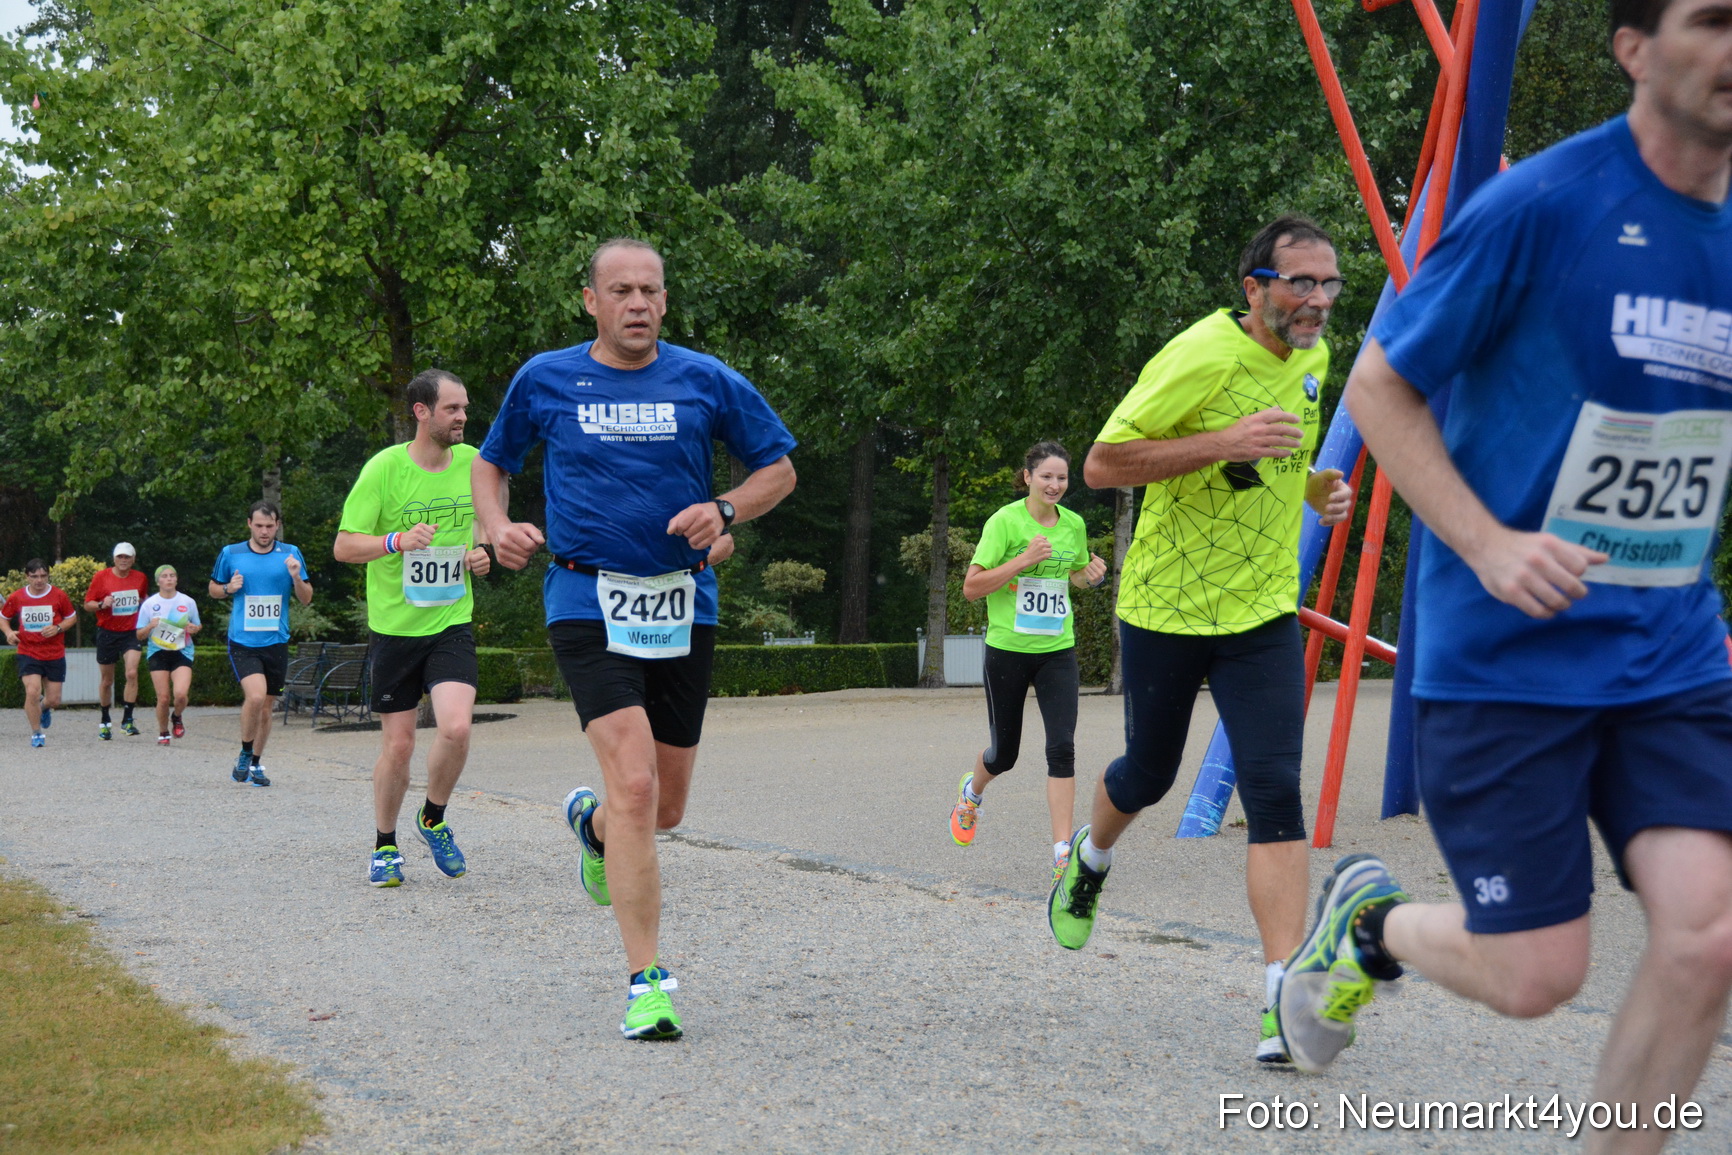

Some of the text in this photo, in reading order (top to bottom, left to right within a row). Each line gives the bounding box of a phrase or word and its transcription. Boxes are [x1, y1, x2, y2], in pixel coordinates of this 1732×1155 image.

[1611, 294, 1732, 354] HUBE
[578, 403, 676, 423] HUBER
[600, 424, 673, 433] TECHNOLOGY
[1574, 455, 1715, 520] 2525
[1579, 531, 1683, 567] Christoph
[410, 560, 461, 584] 3014
[115, 596, 138, 607] 2078
[248, 604, 280, 617] 3018
[609, 587, 686, 622] 2420
[1023, 591, 1067, 615] 3015
[25, 612, 50, 623] 2605
[160, 630, 177, 643] 175
[628, 631, 672, 645] Werner
[1473, 875, 1509, 905] 36
